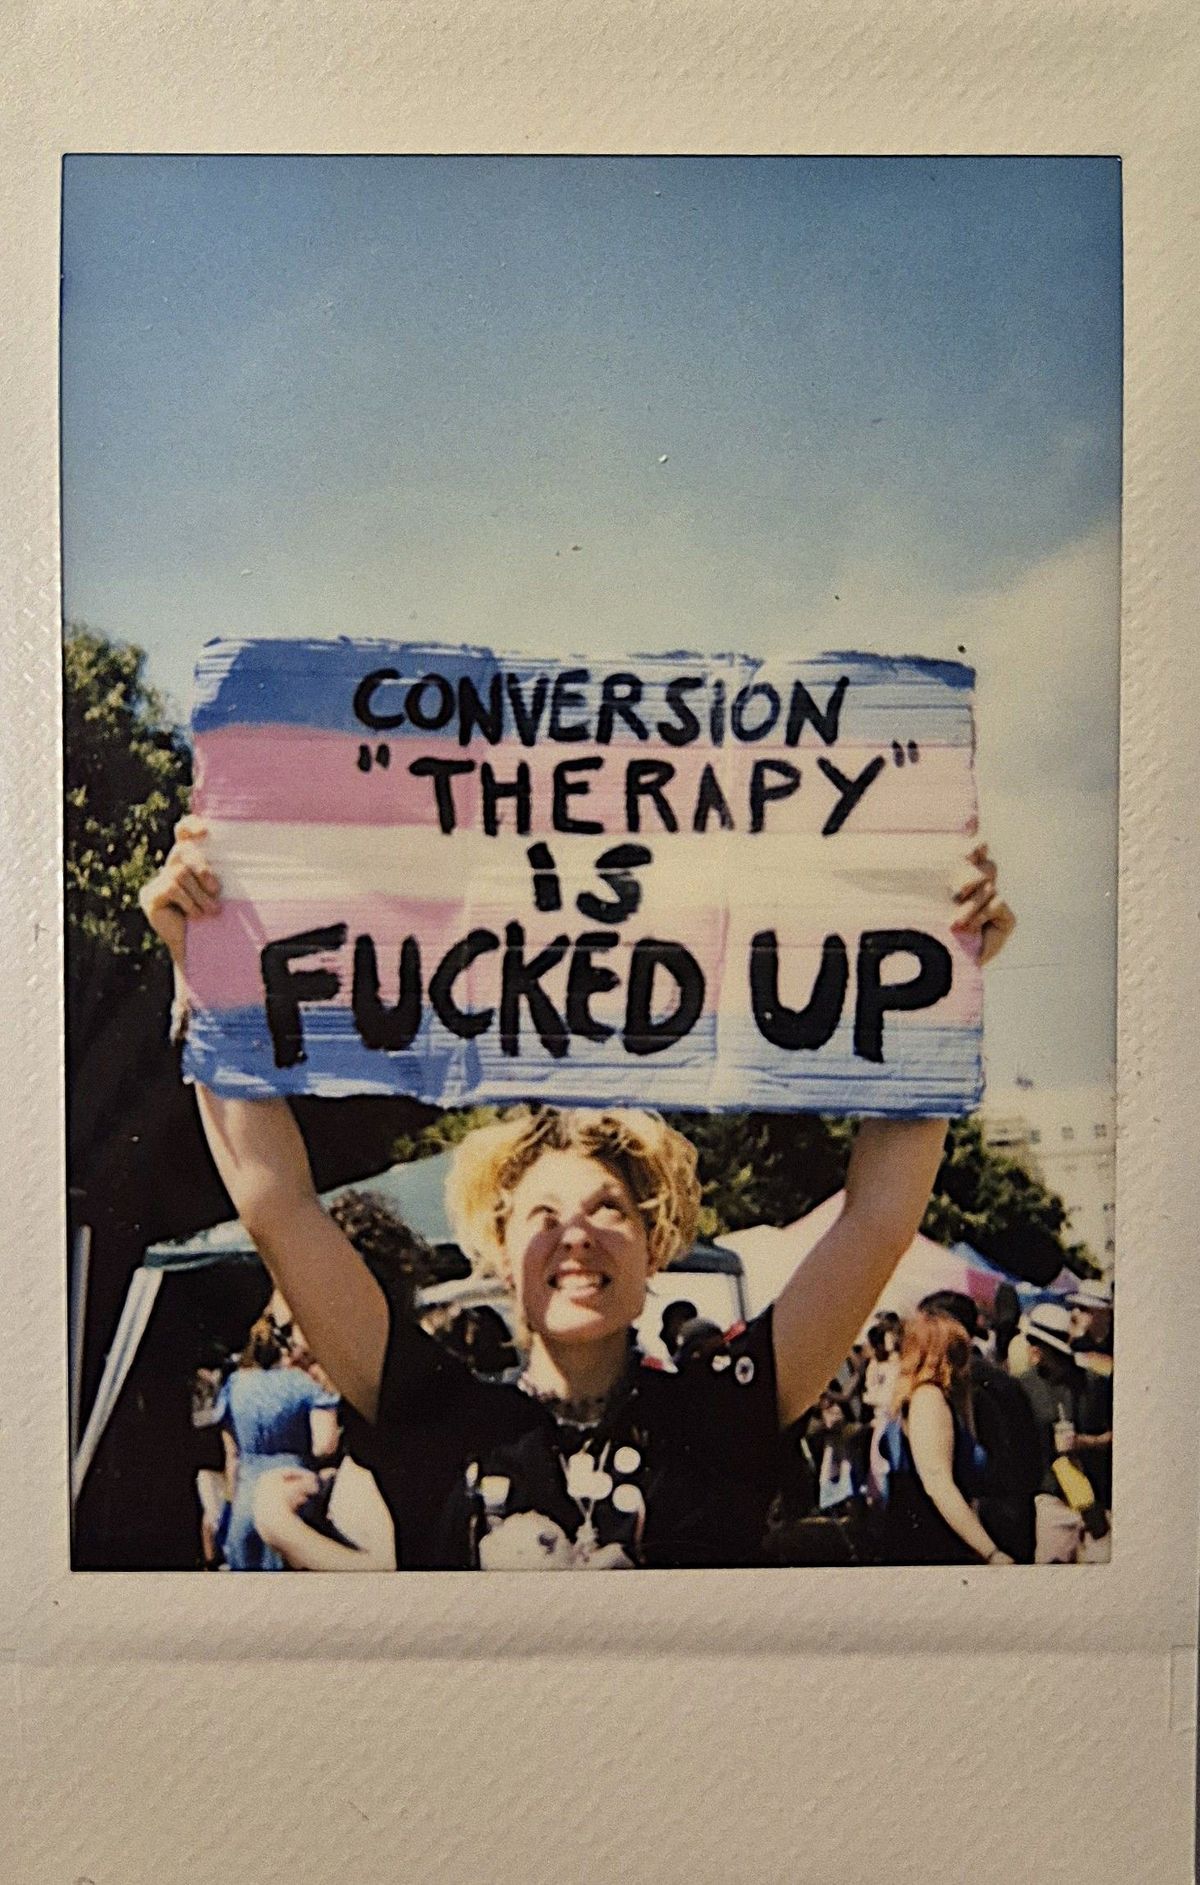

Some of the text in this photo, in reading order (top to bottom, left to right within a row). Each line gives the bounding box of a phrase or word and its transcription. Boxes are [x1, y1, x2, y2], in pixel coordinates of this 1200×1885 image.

[353, 668, 849, 747] CONVERSION
[358, 740, 919, 836] "THERAPY"
[260, 921, 954, 1069] FUCKED UP
